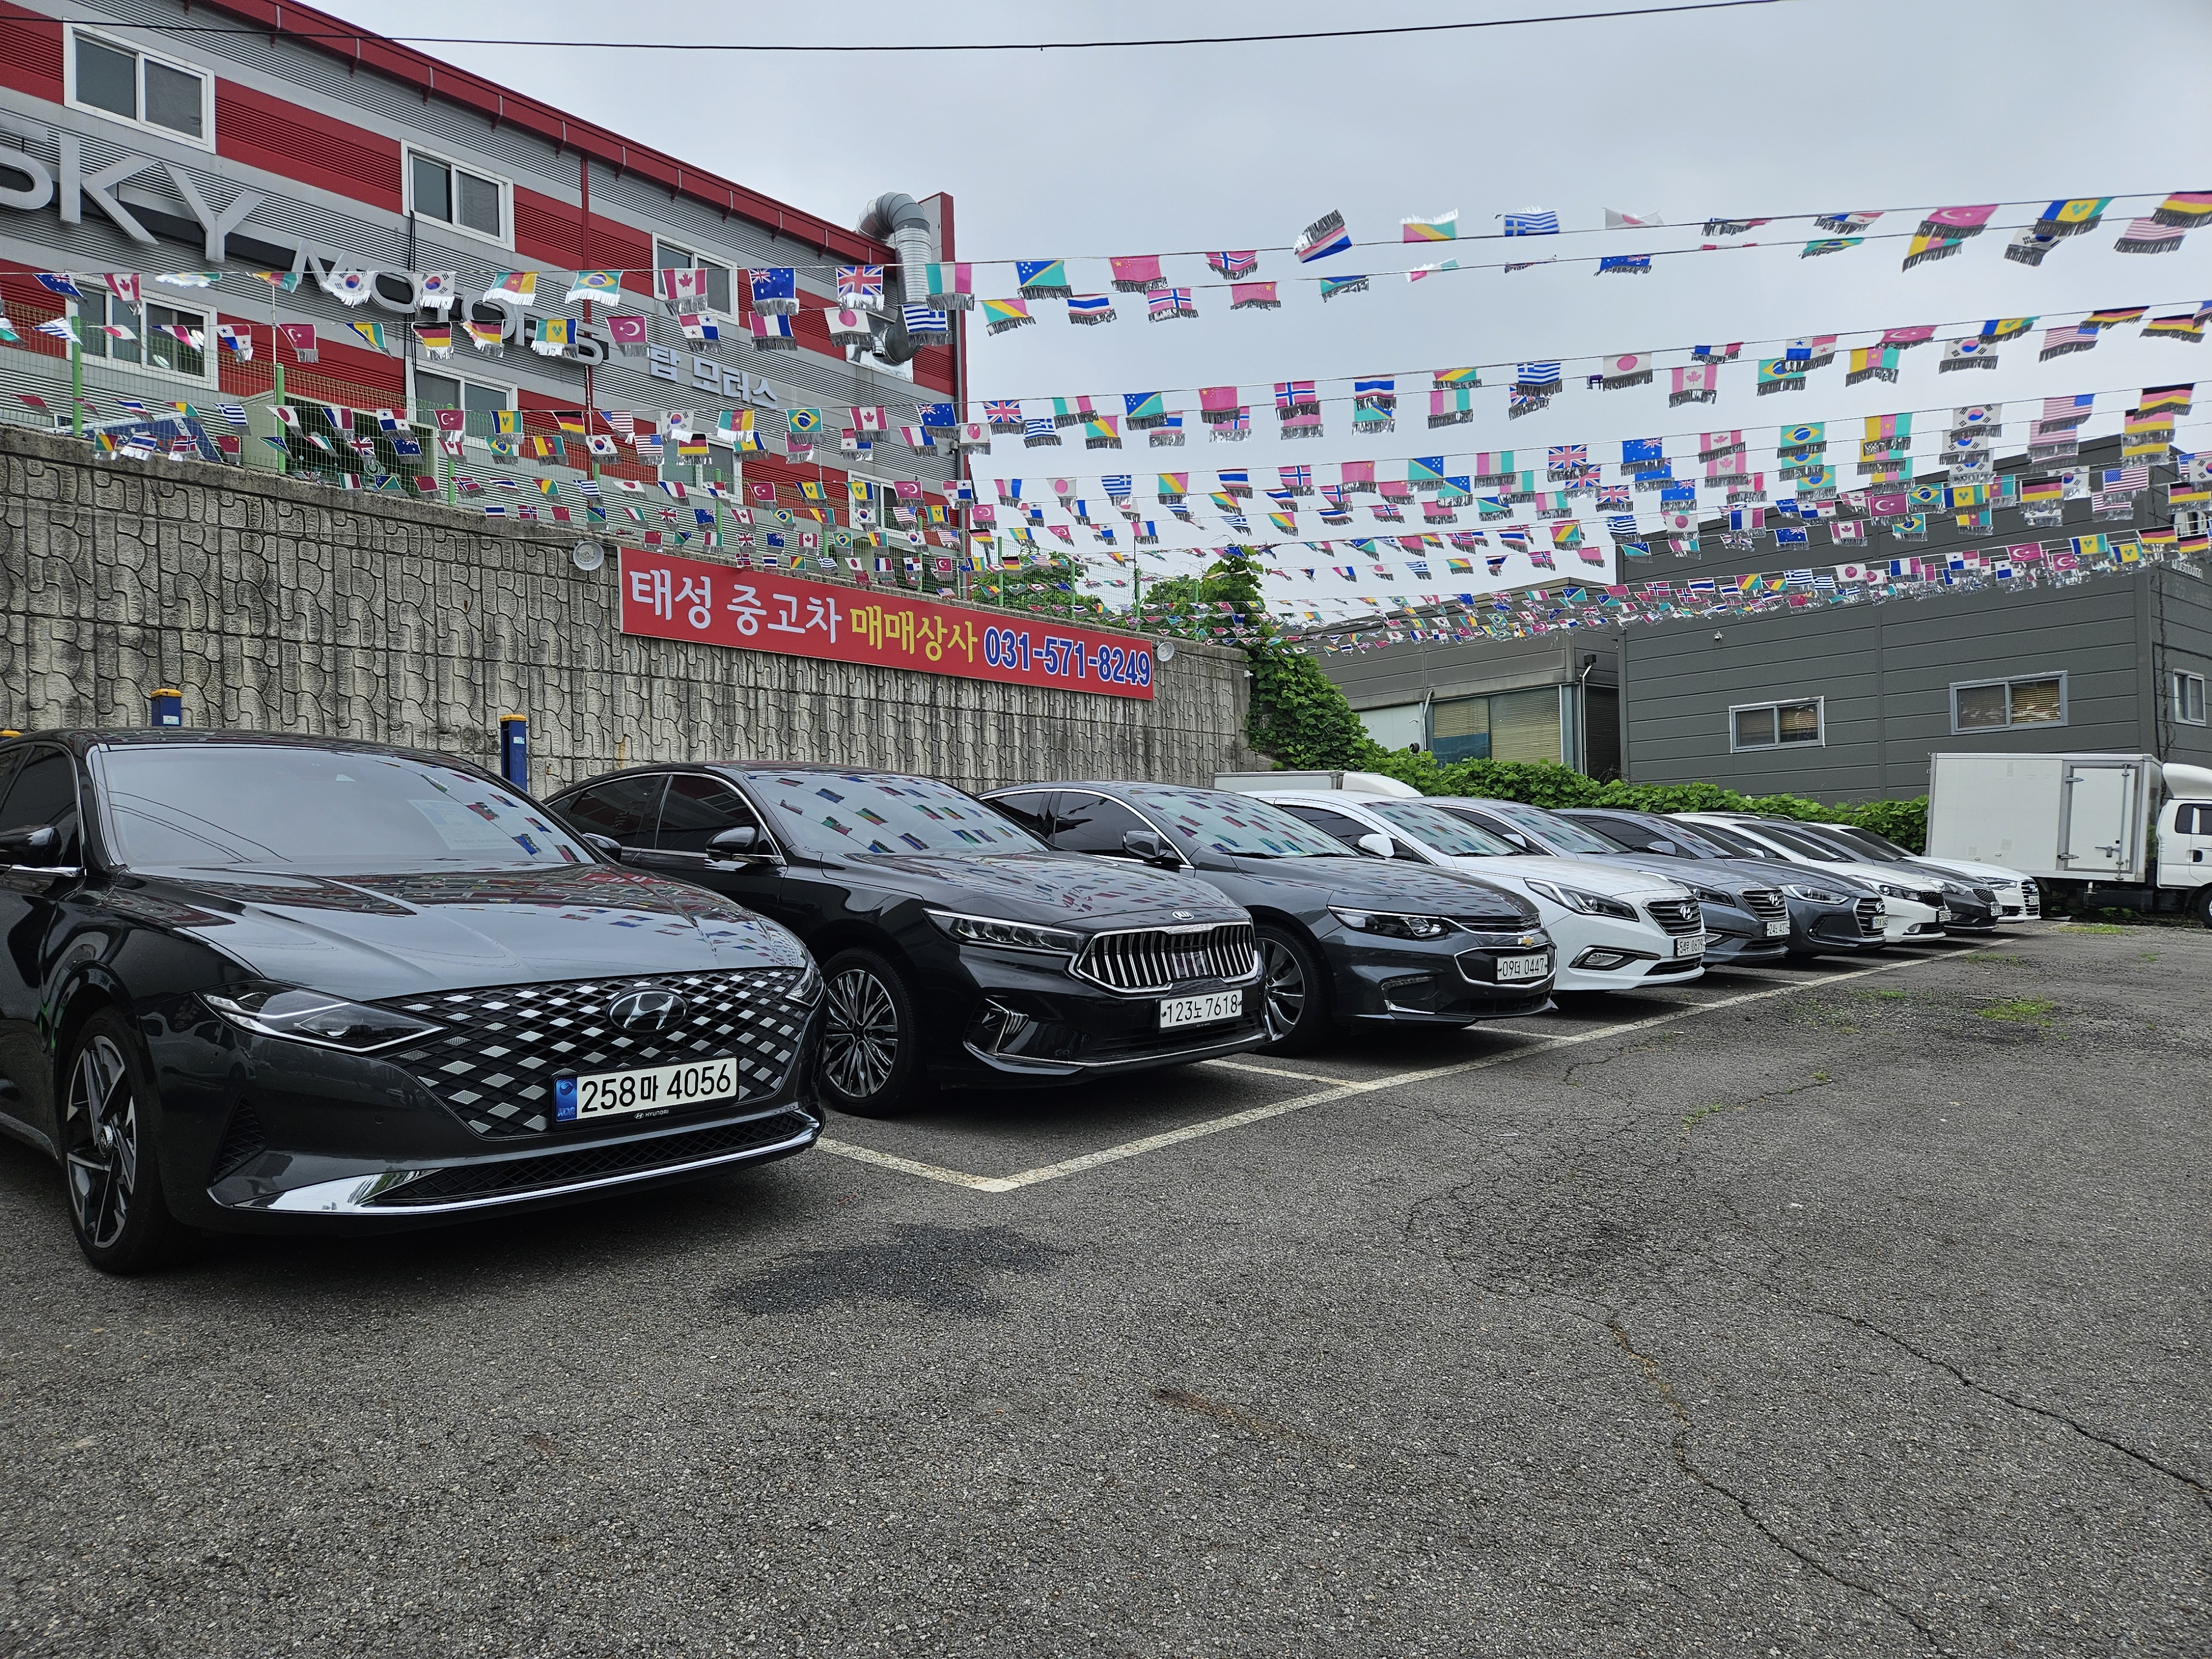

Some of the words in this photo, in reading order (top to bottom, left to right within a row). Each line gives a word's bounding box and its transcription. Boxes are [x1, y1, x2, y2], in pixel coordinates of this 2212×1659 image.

[649, 343, 681, 382] 탑
[692, 356, 778, 409] 모터스
[629, 569, 711, 629] 태성
[727, 584, 842, 644] 중고차
[850, 605, 978, 663] 매매상사
[984, 626, 1151, 687] 031-571-8249
[1173, 911, 1193, 919] KIA
[1692, 938, 1703, 952] 0679
[1503, 960, 1521, 977] 09더
[1524, 958, 1545, 975] 0447
[1167, 1001, 1202, 1023] 123노
[1206, 994, 1238, 1017] 7618
[581, 1074, 659, 1113] 258마
[666, 1063, 731, 1099] 4056
[557, 1107, 576, 1117] KOR
[645, 1109, 669, 1118] HYUNDAI
